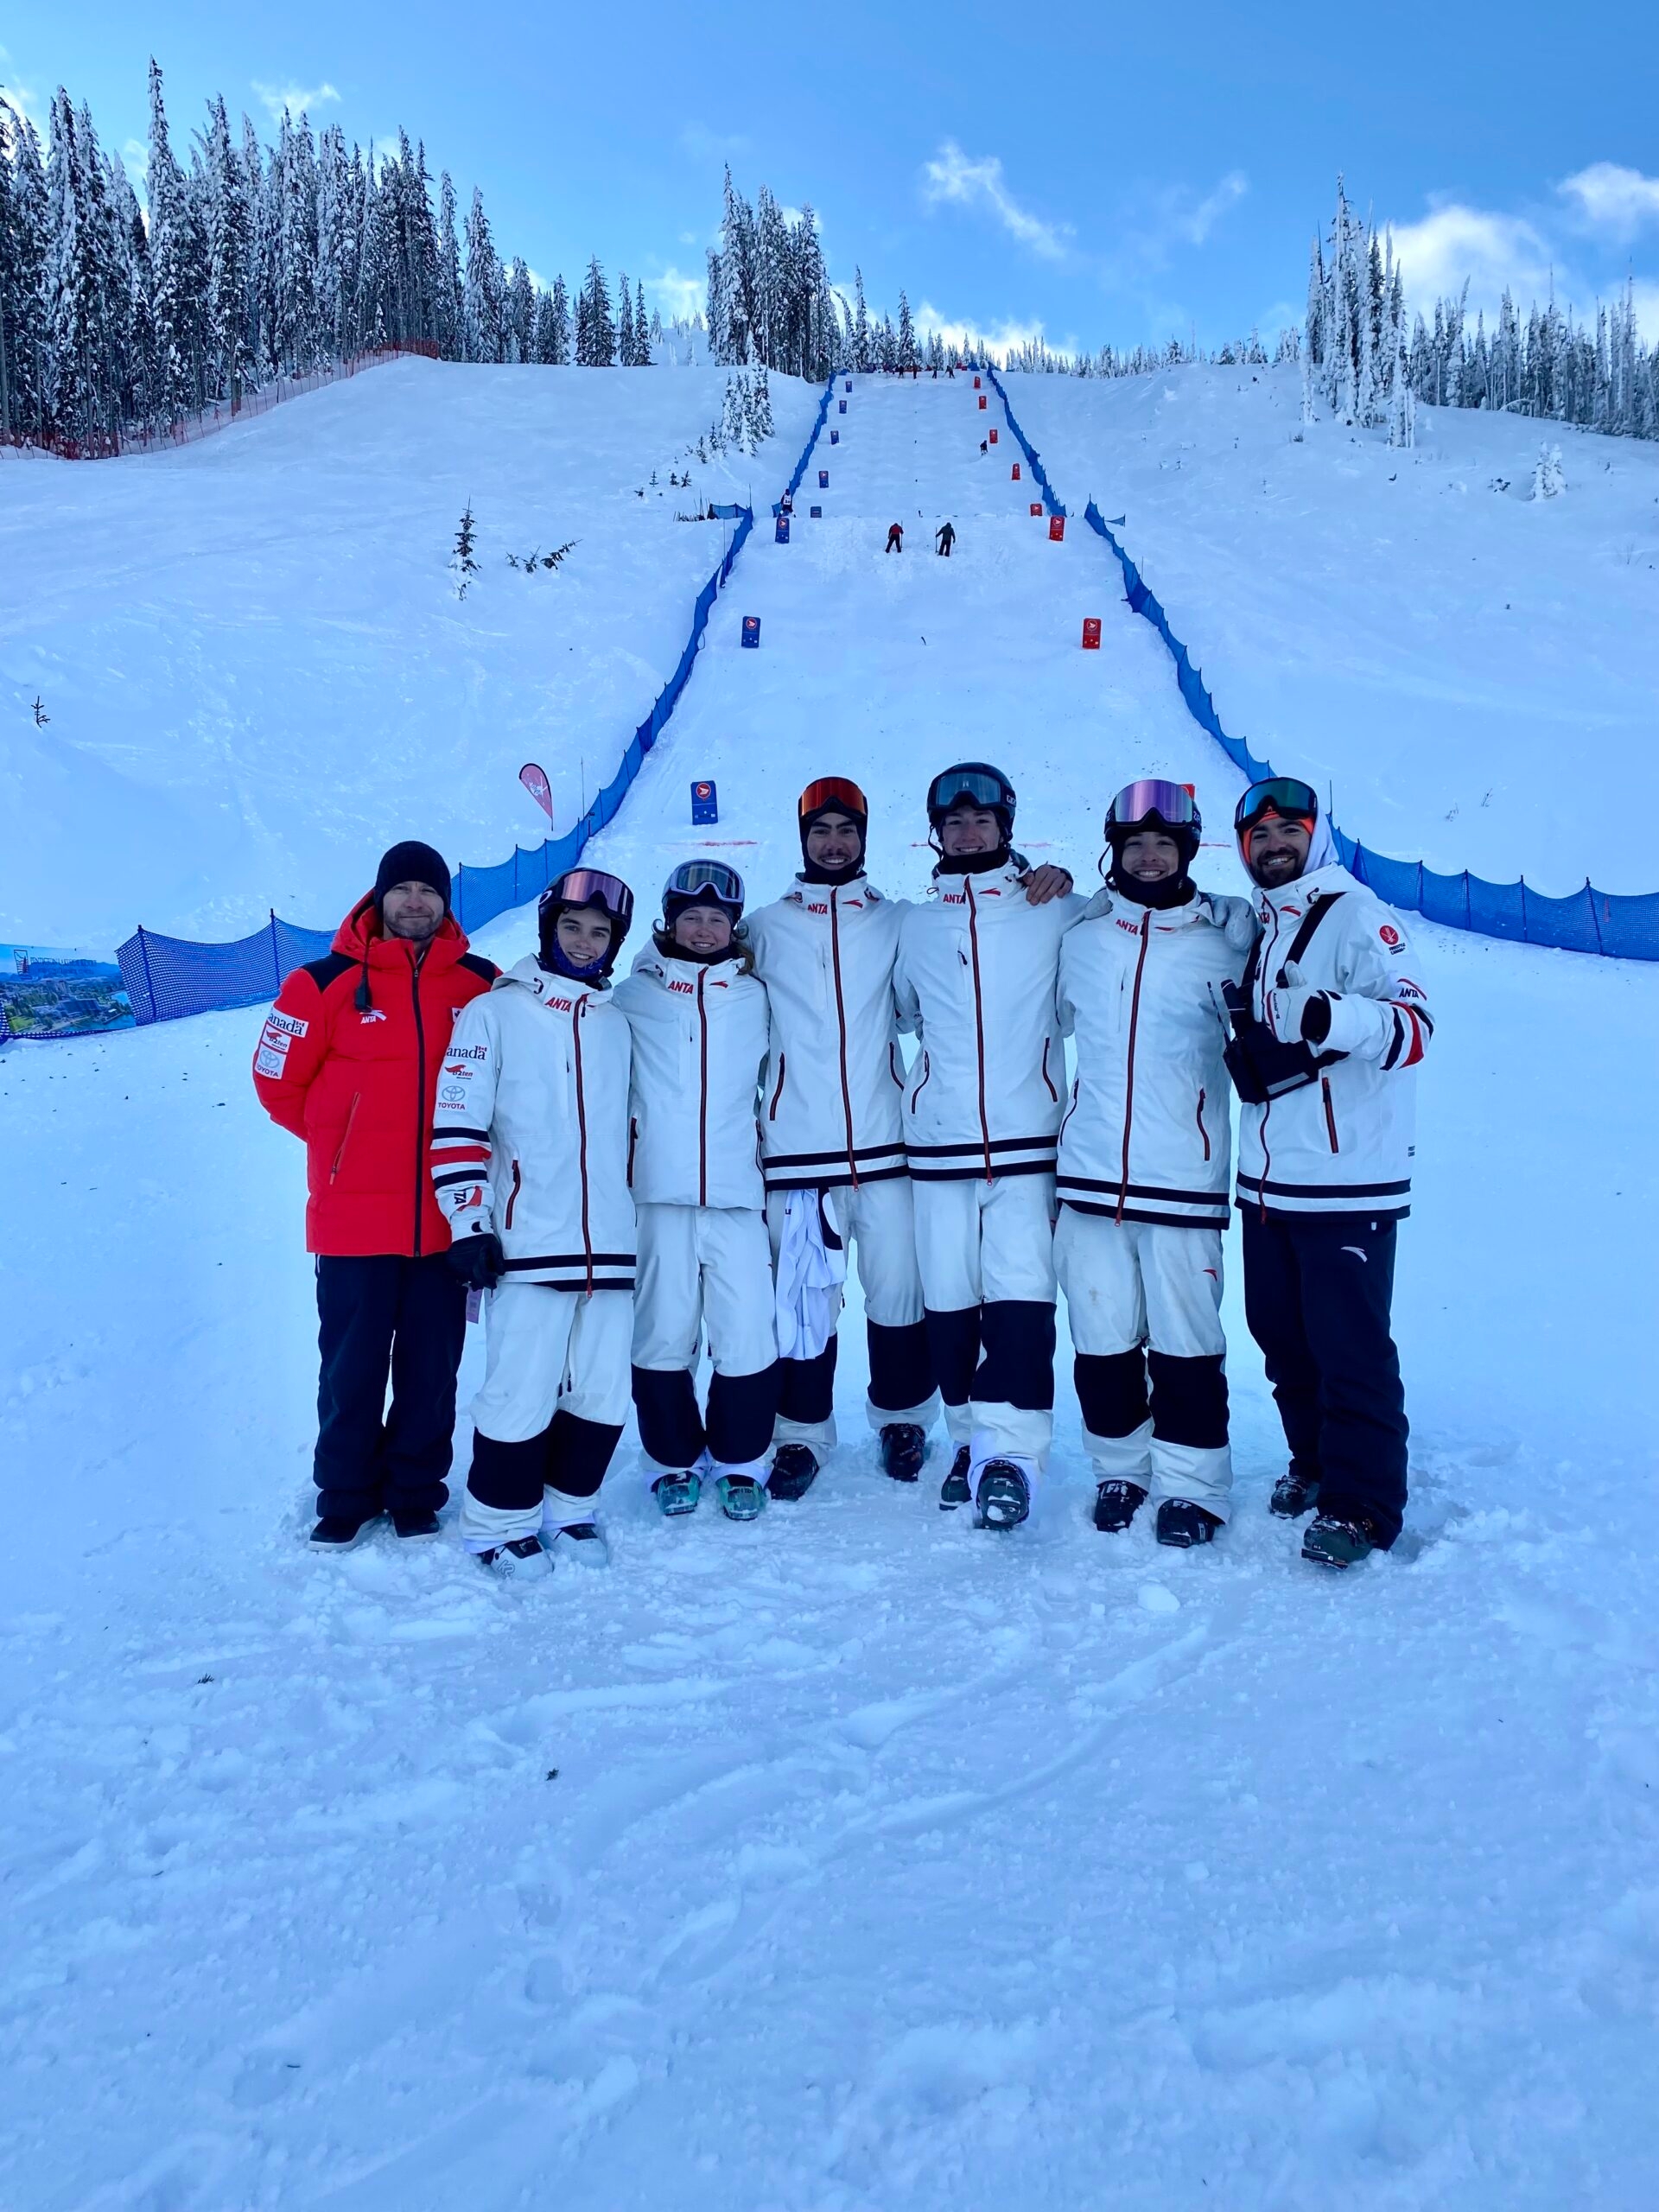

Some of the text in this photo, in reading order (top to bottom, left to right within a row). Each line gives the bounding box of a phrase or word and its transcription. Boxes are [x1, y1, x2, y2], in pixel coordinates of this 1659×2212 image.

[807, 903, 828, 915] ANTA
[1116, 918, 1139, 936] ANTA
[667, 980, 693, 995] ANTA
[1398, 988, 1420, 999] ANTA
[544, 996, 572, 1013] ANTA
[268, 1013, 303, 1036] anada
[359, 1015, 377, 1025] ANTA
[446, 1045, 486, 1061] anada
[438, 1102, 466, 1110] TOYOTA
